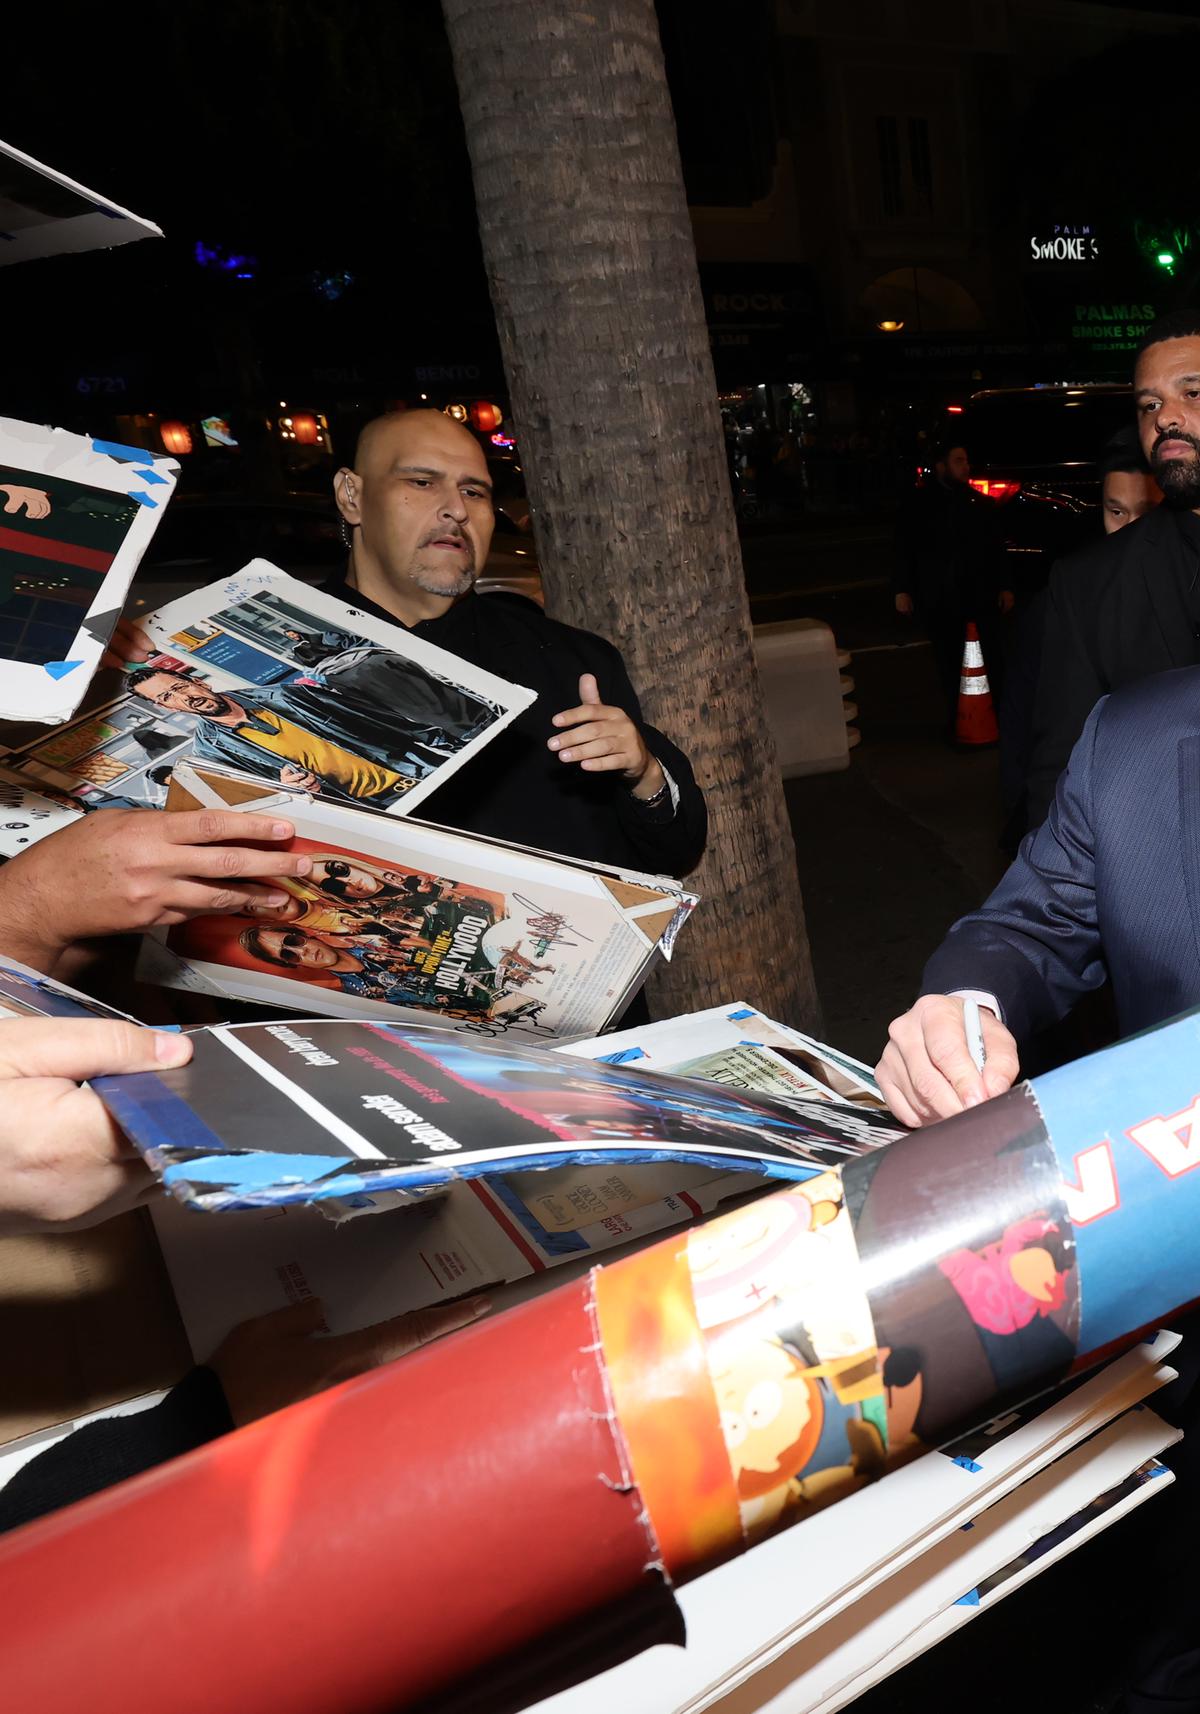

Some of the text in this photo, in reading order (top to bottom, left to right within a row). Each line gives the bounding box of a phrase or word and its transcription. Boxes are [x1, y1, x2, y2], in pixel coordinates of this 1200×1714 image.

[713, 290, 786, 312] ROCK
[1075, 304, 1156, 321] PALMAS
[1072, 326, 1122, 338] SMOKE
[415, 364, 480, 384] BENTO
[434, 914, 488, 990] HOLLYWOOD
[780, 1071, 807, 1088] NETFLIX
